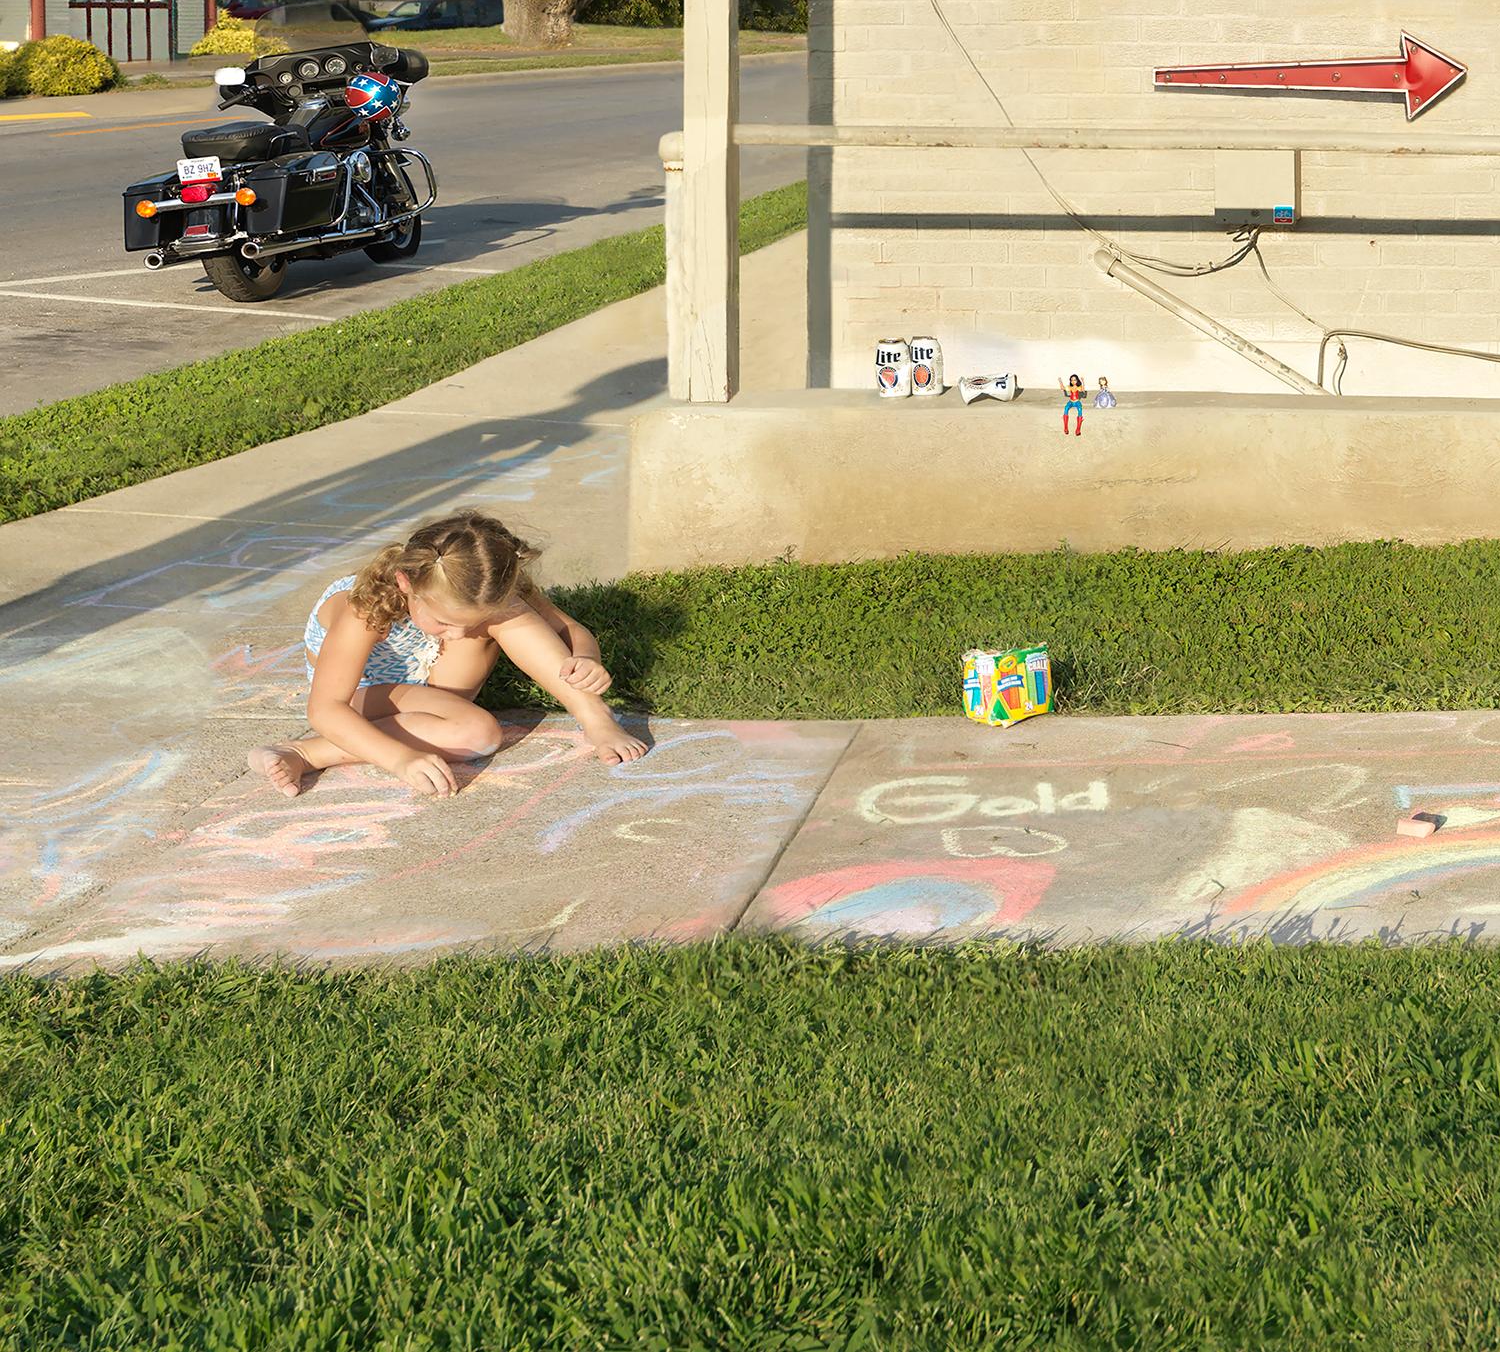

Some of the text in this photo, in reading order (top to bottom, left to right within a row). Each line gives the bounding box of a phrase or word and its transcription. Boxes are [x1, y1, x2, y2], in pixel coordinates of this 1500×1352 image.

[876, 348, 902, 367] Lite
[910, 345, 934, 364] Lite
[857, 775, 1110, 825] Gold
